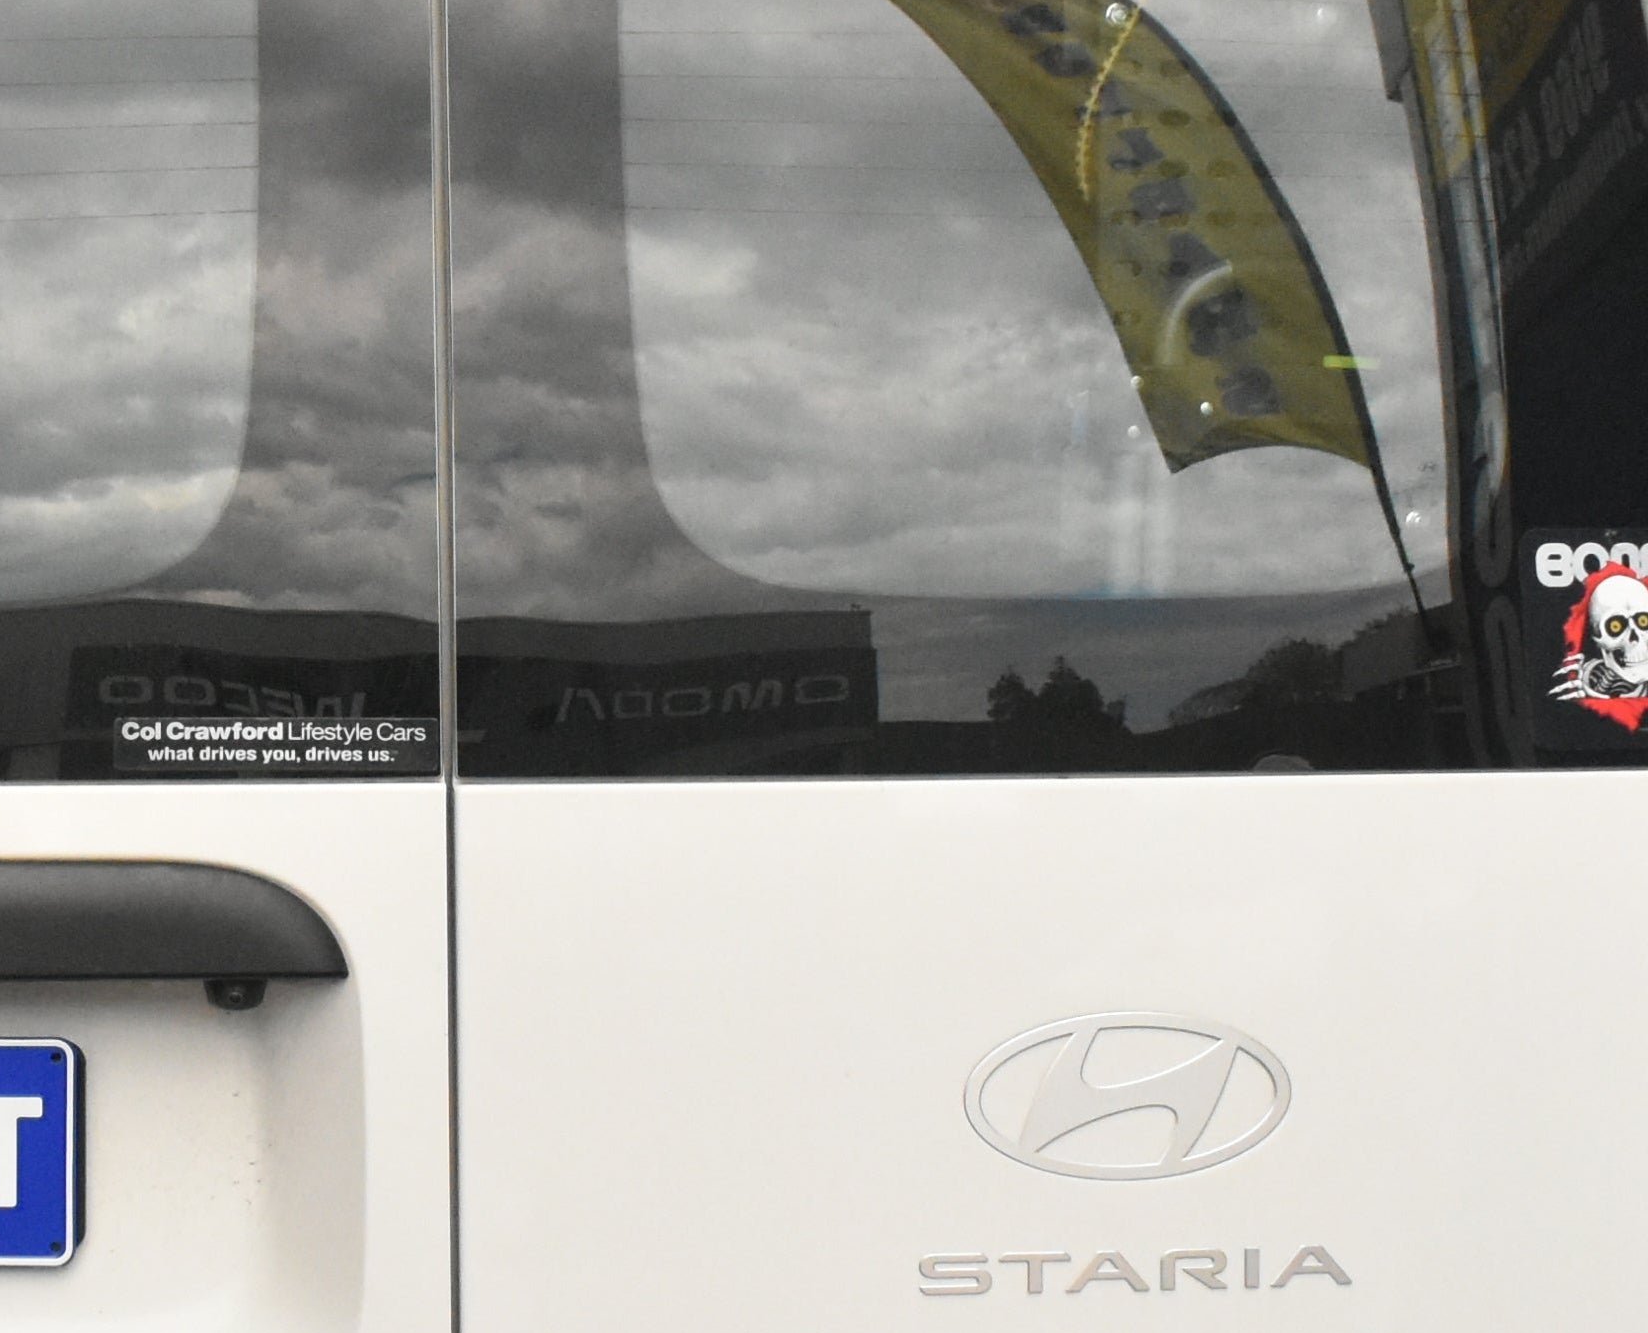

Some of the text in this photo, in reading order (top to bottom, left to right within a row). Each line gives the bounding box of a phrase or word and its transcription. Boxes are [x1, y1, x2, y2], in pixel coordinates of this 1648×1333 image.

[121, 721, 427, 745] Col Crawford Lifestyle Cars
[148, 747, 395, 764] what drives you, drives us.
[918, 1244, 1352, 1296] STARIA
